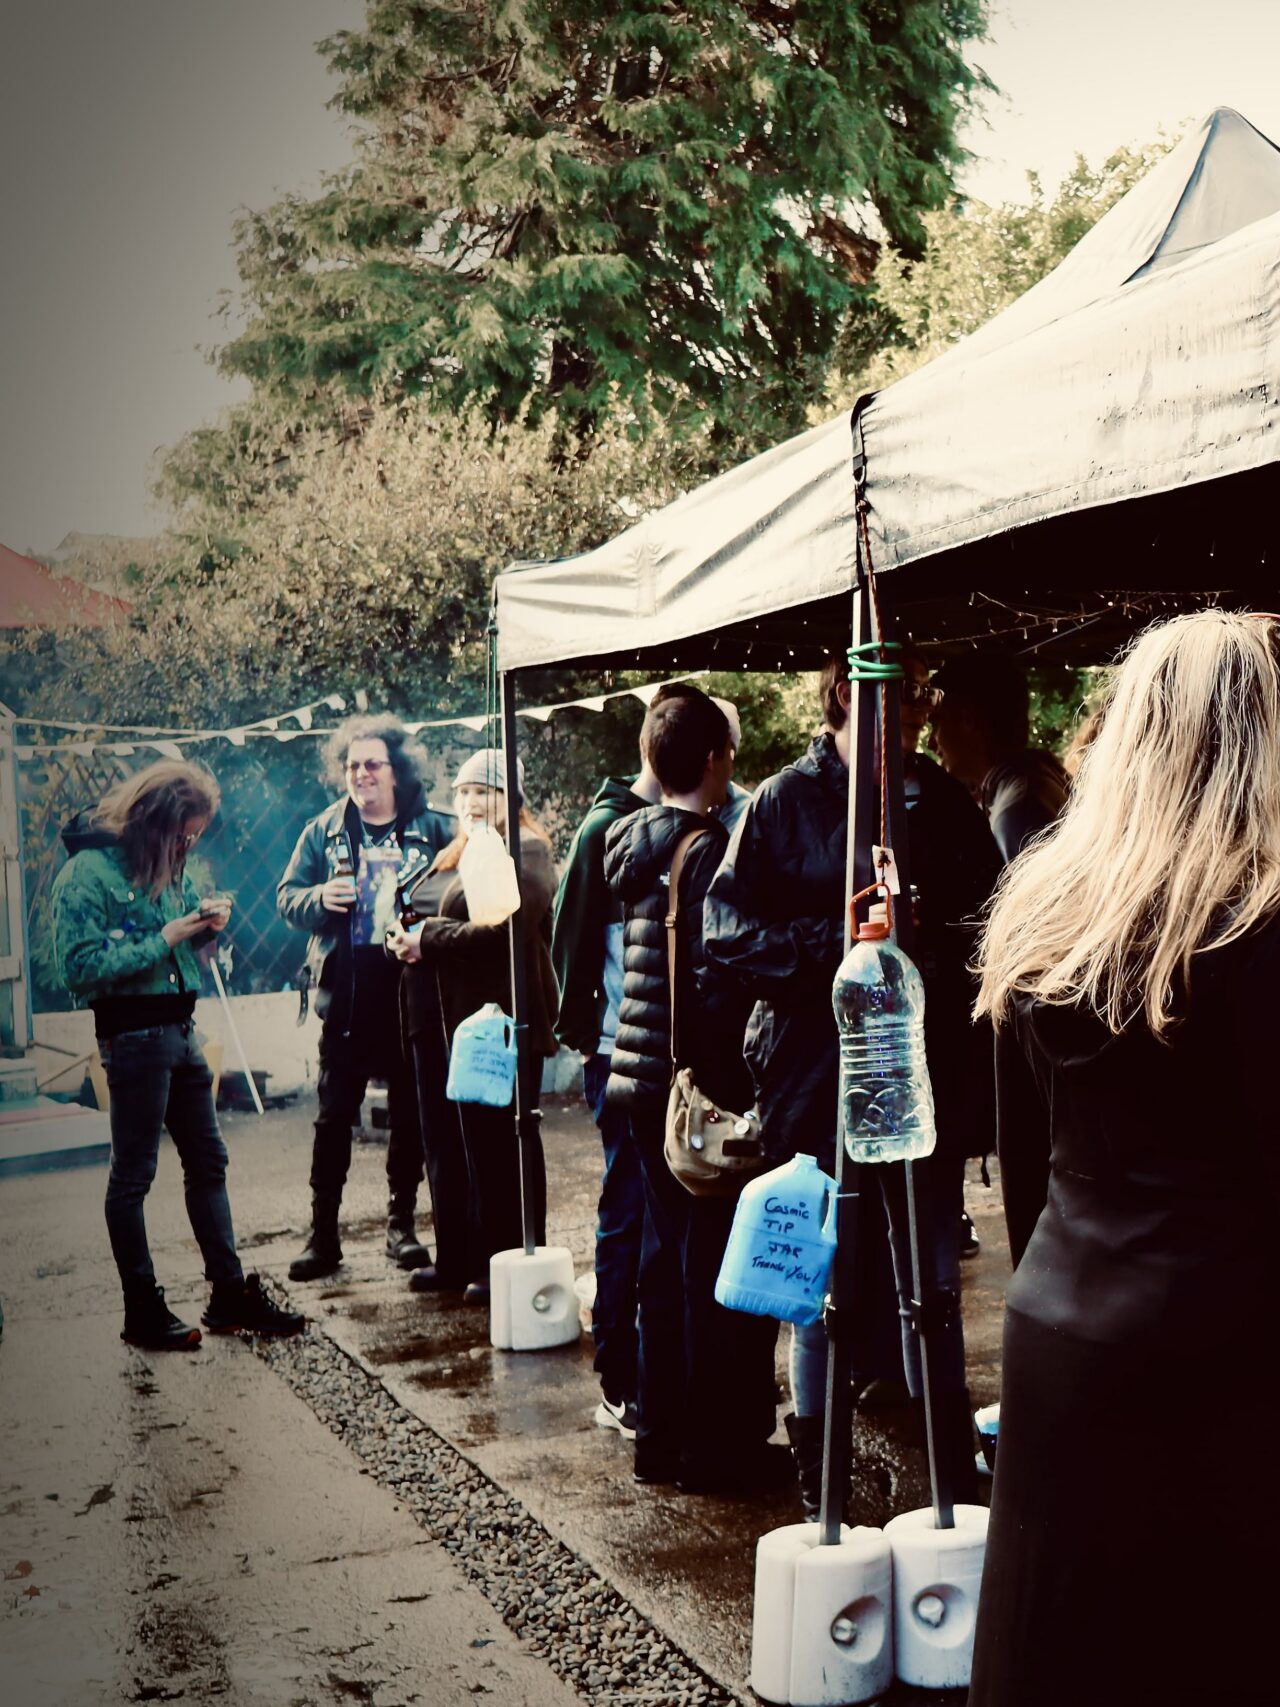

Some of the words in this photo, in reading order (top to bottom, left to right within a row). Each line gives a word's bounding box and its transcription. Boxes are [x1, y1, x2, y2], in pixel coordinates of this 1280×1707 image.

[763, 1197, 810, 1219] Cosmic
[763, 1218, 795, 1232] TIP
[768, 1240, 803, 1258] JAR
